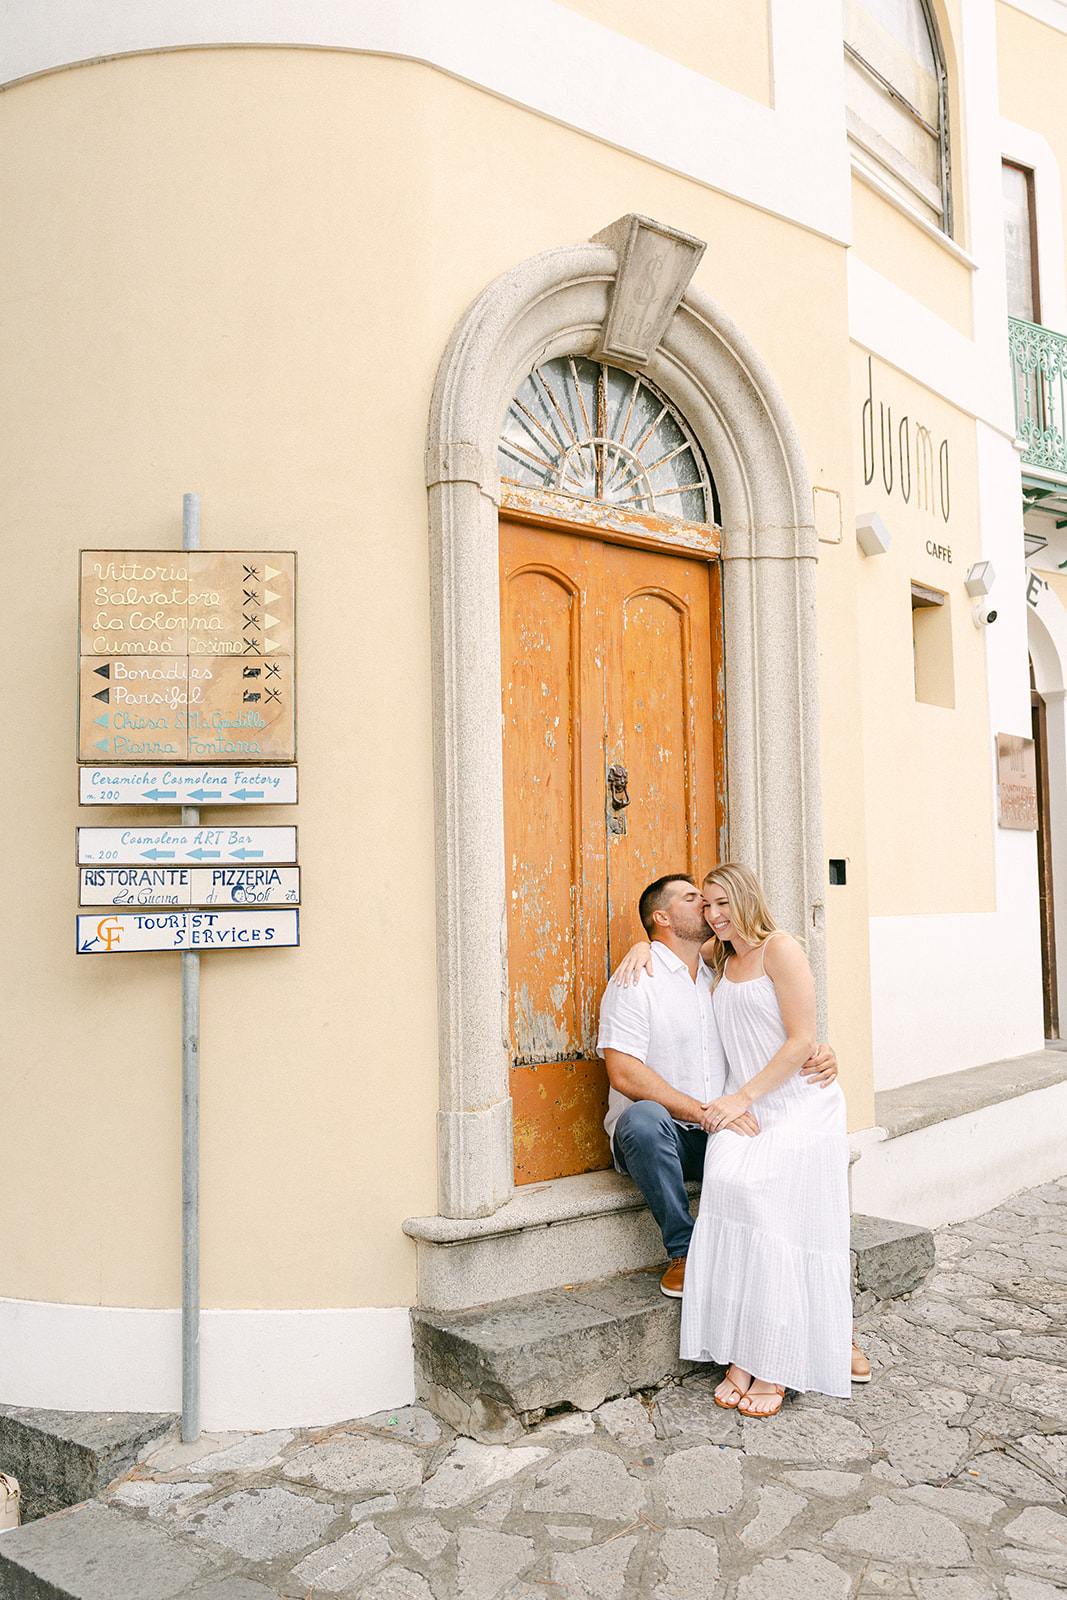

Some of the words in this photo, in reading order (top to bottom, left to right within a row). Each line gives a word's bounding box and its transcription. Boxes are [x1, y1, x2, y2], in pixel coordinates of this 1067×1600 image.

[862, 355, 950, 523] duomo
[926, 540, 952, 564] CAFFÈ
[93, 563, 192, 581] Vittoria
[94, 587, 221, 606] Salvatore
[92, 612, 124, 630] La
[129, 611, 224, 630] Colonna
[188, 637, 242, 654] Cosimo
[113, 662, 213, 680] Bonadies
[113, 686, 206, 710] Parsifal
[113, 711, 169, 729] Chiesa
[188, 735, 261, 754] Fontana
[91, 771, 157, 786] Ceramiche
[162, 771, 228, 785] Cosmolena
[234, 771, 281, 788] Factory
[100, 790, 120, 800] 200
[121, 831, 188, 845] Cosmolena
[193, 831, 224, 845] ART
[228, 831, 253, 845] Bar
[98, 850, 119, 860] 200
[85, 870, 188, 886] RISTORANTE
[212, 869, 282, 886] PIZZERIA
[112, 888, 134, 905] La
[137, 887, 179, 905] Cucina
[206, 887, 219, 904] di
[133, 914, 219, 930] TOURIST
[173, 927, 276, 946] SERVICES
